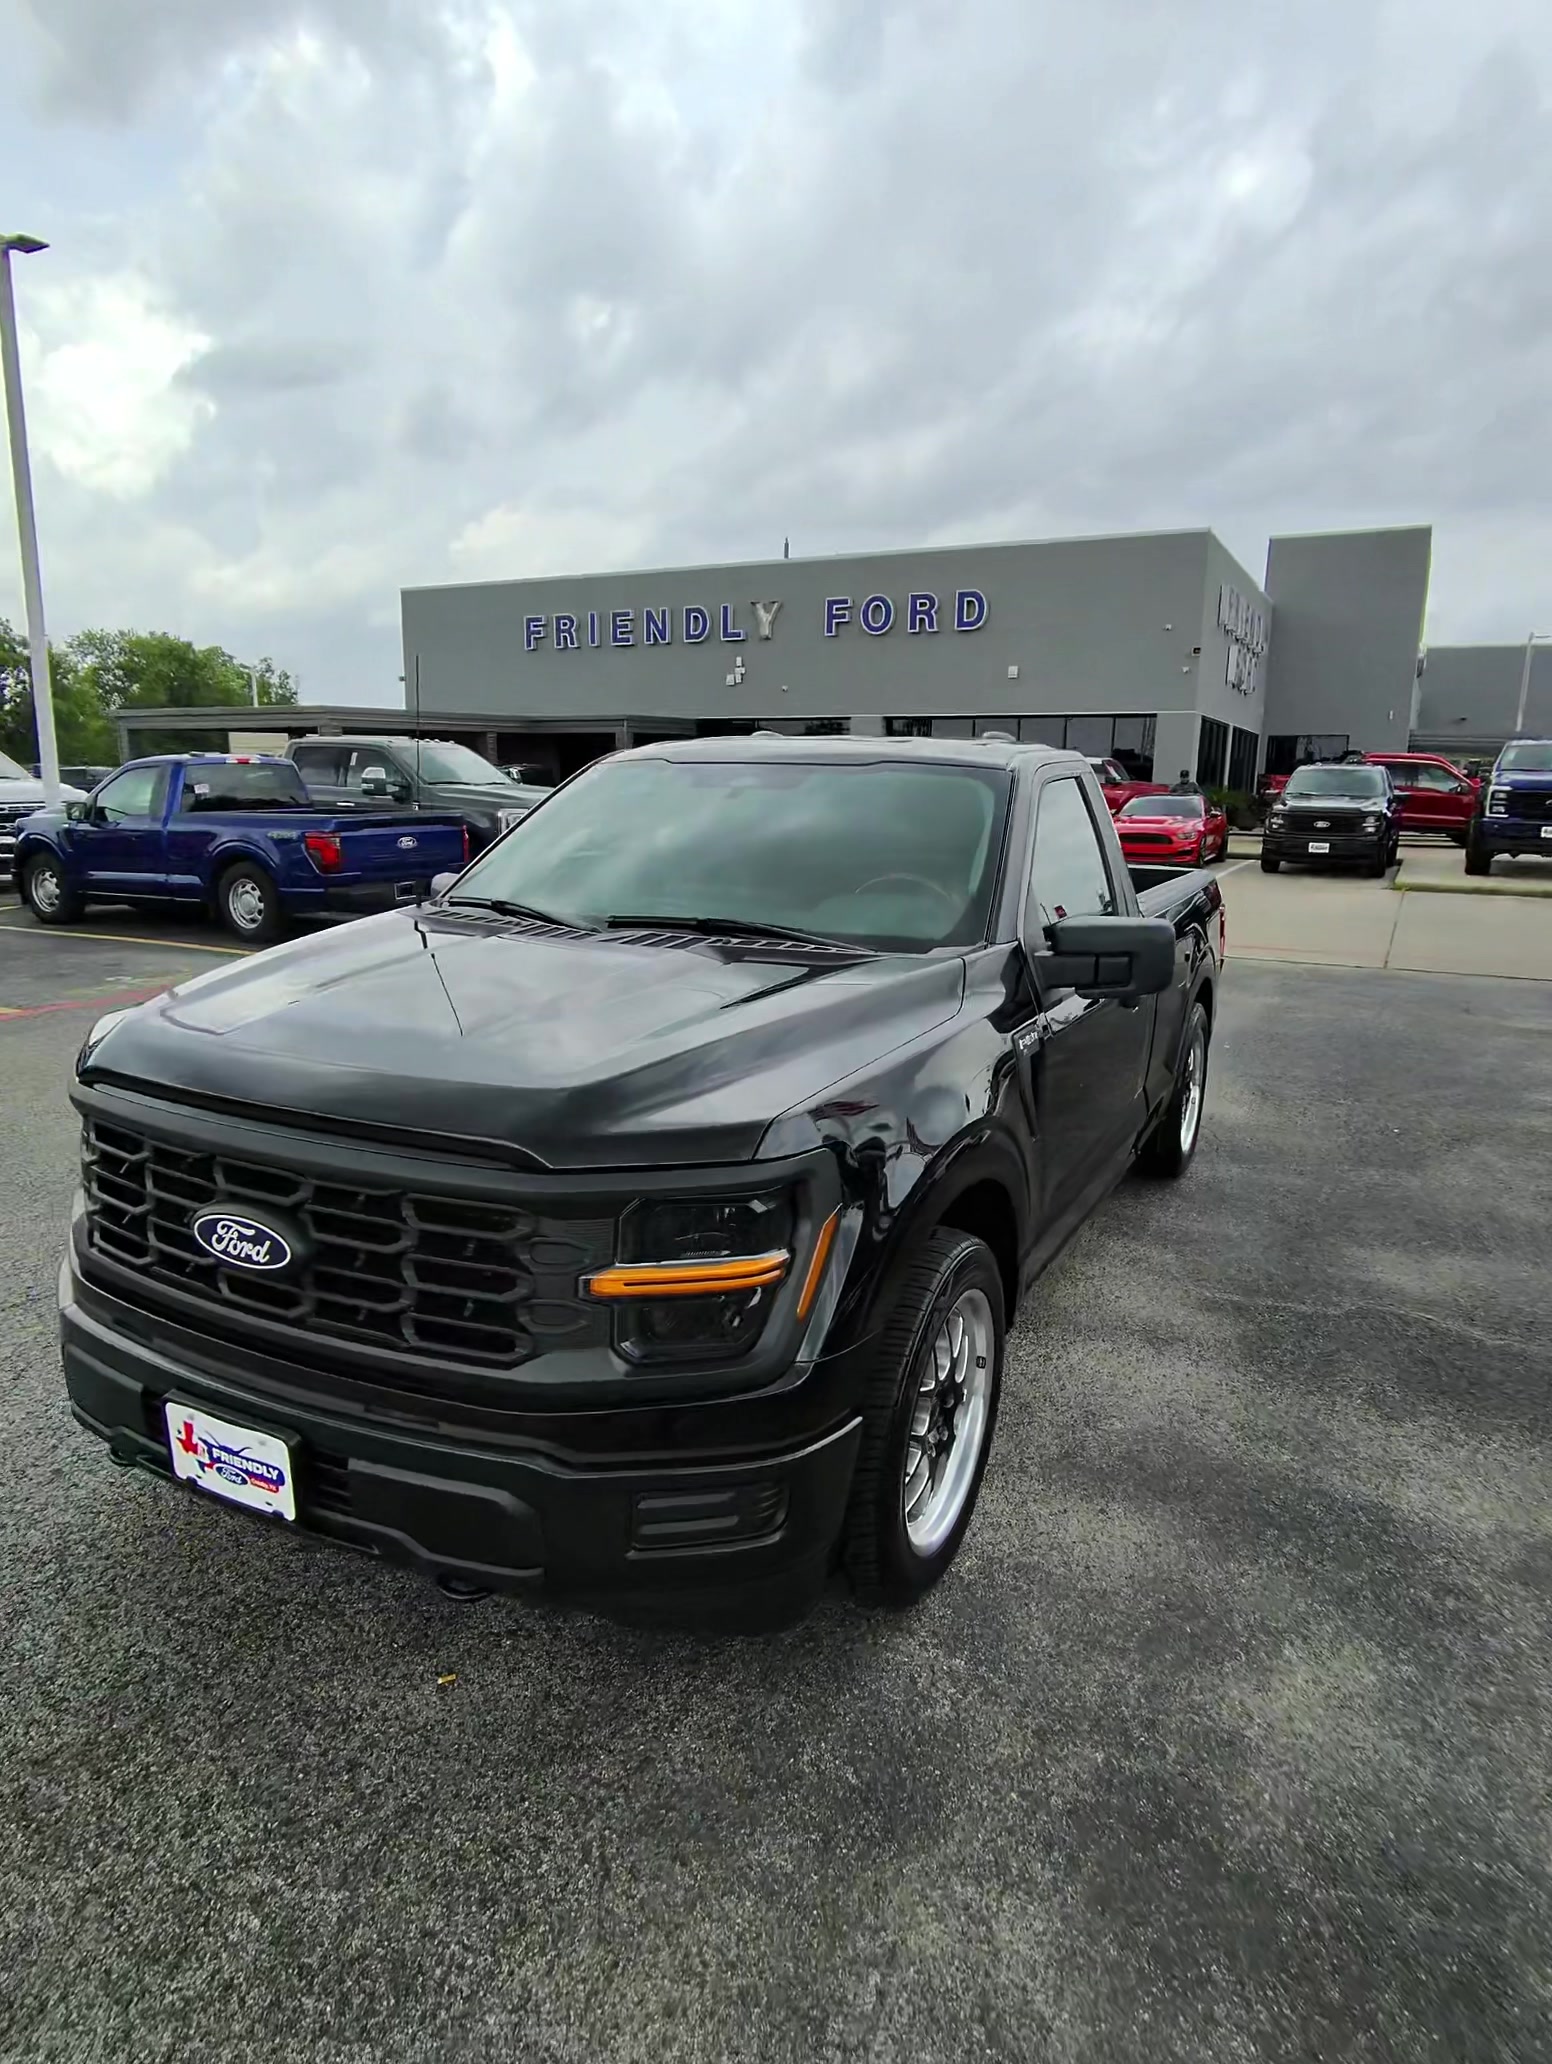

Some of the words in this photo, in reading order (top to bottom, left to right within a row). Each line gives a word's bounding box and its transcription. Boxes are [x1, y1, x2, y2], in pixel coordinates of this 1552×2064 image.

[523, 600, 782, 650] FRIENDLY
[824, 589, 989, 637] FORD
[211, 1220, 271, 1263] Ford
[212, 1447, 279, 1480] FRIENDLY
[221, 1467, 242, 1484] Ford
